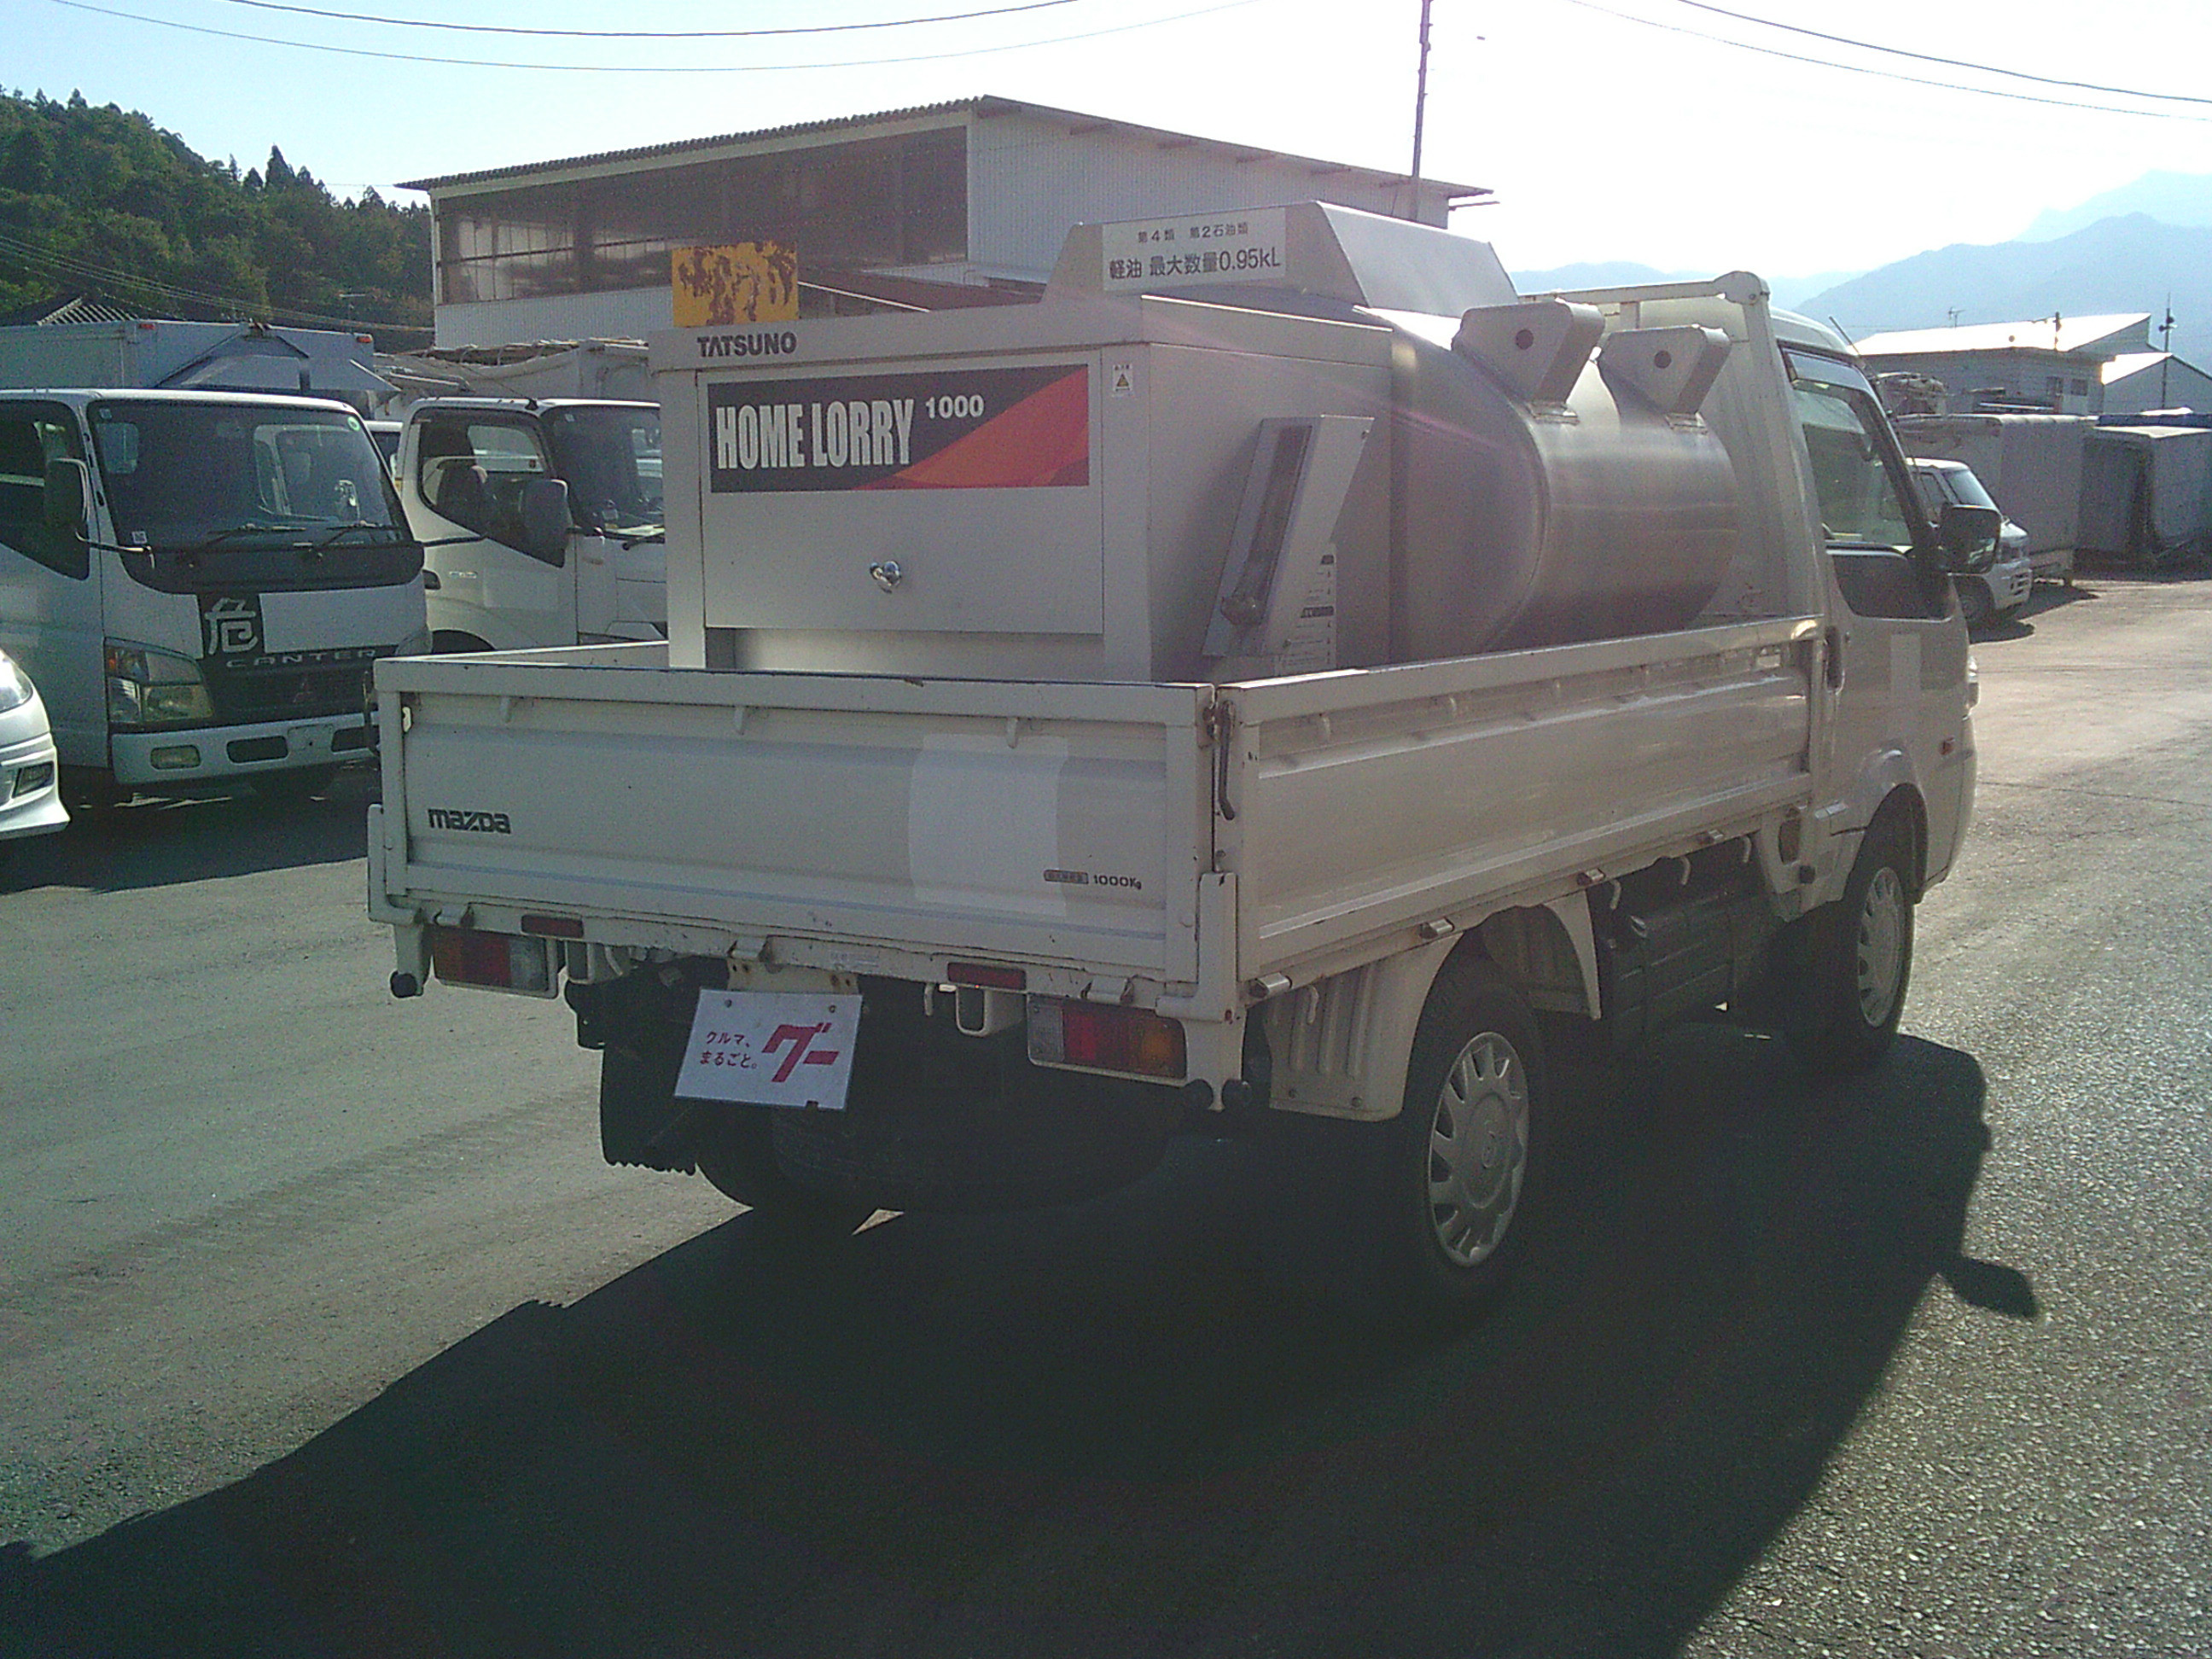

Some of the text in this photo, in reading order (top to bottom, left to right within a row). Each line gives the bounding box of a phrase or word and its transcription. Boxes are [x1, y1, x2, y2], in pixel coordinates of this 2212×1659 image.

[1109, 259, 1142, 279] 軽油
[696, 332, 797, 358] TATSUNO
[716, 394, 985, 470] HOME LORRY 1000
[226, 649, 375, 668] CANTER
[707, 1031, 750, 1048] クルマ、
[700, 1051, 758, 1069] まるごと。
[761, 1022, 840, 1083] グー
